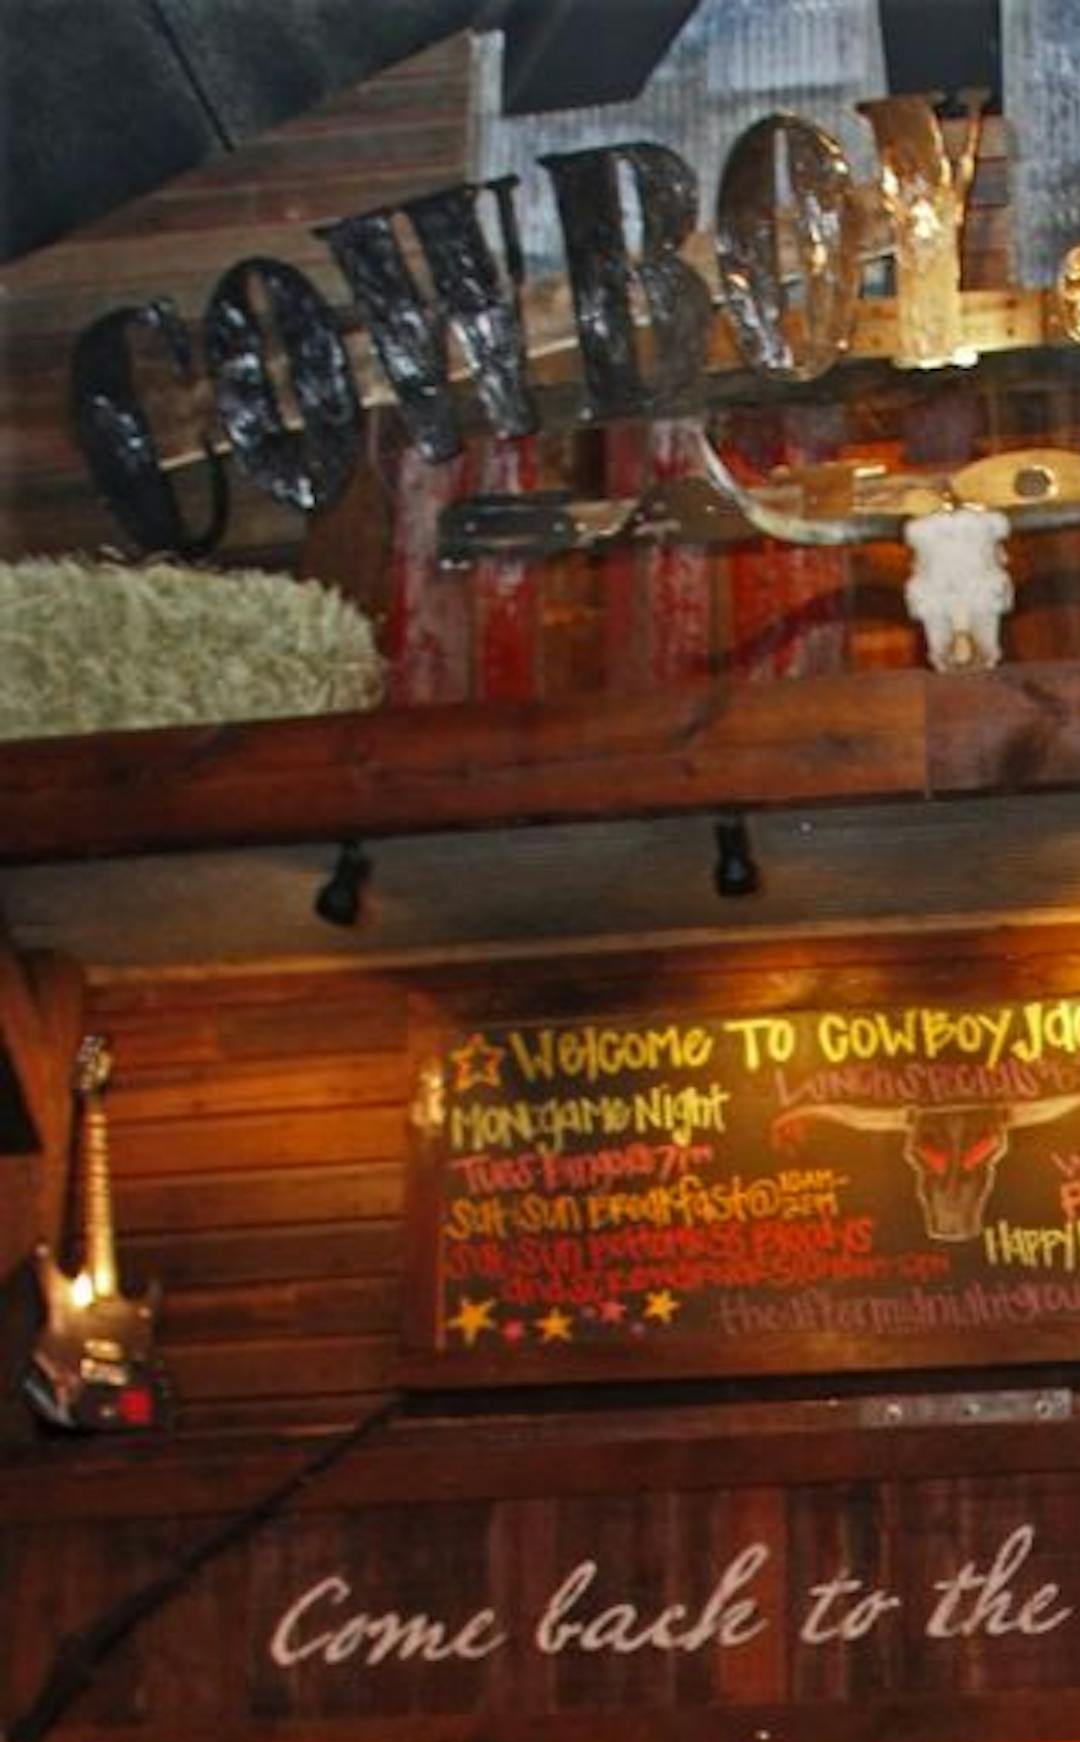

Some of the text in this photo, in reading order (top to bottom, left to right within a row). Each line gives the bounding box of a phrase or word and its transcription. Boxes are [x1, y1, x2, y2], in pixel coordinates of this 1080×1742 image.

[72, 88, 994, 558] COWBOY
[270, 1575, 507, 1667] Come
[536, 1542, 769, 1656] back
[799, 1569, 901, 1645] to
[925, 1525, 1072, 1638] the
